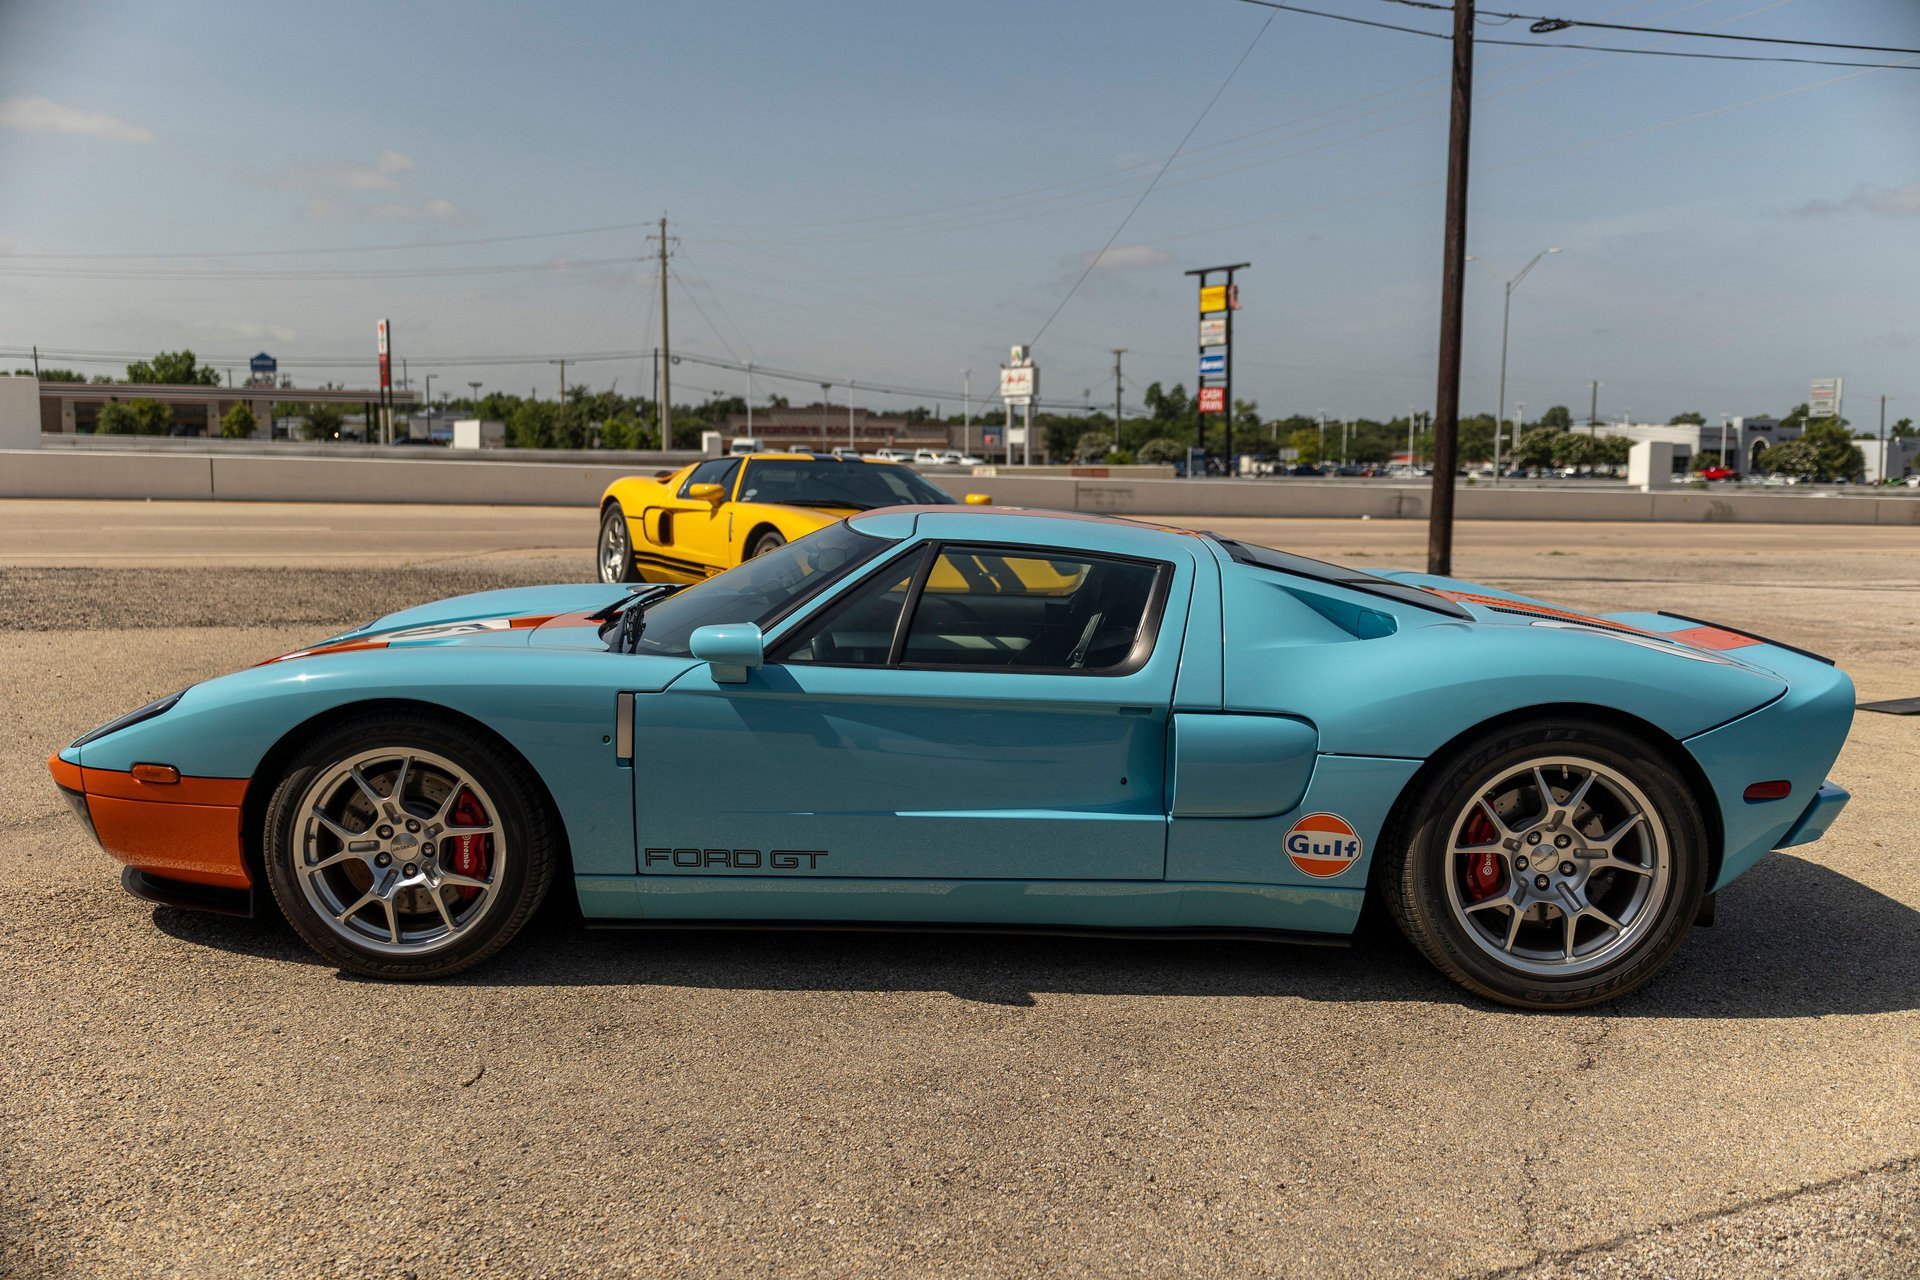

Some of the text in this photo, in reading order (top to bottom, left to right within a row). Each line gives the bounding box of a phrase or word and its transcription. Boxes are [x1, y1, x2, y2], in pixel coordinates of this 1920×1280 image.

[1201, 389, 1223, 399] CASH
[463, 841, 471, 870] brembo
[1287, 834, 1357, 858] Gulf
[644, 847, 829, 870] FORD GT
